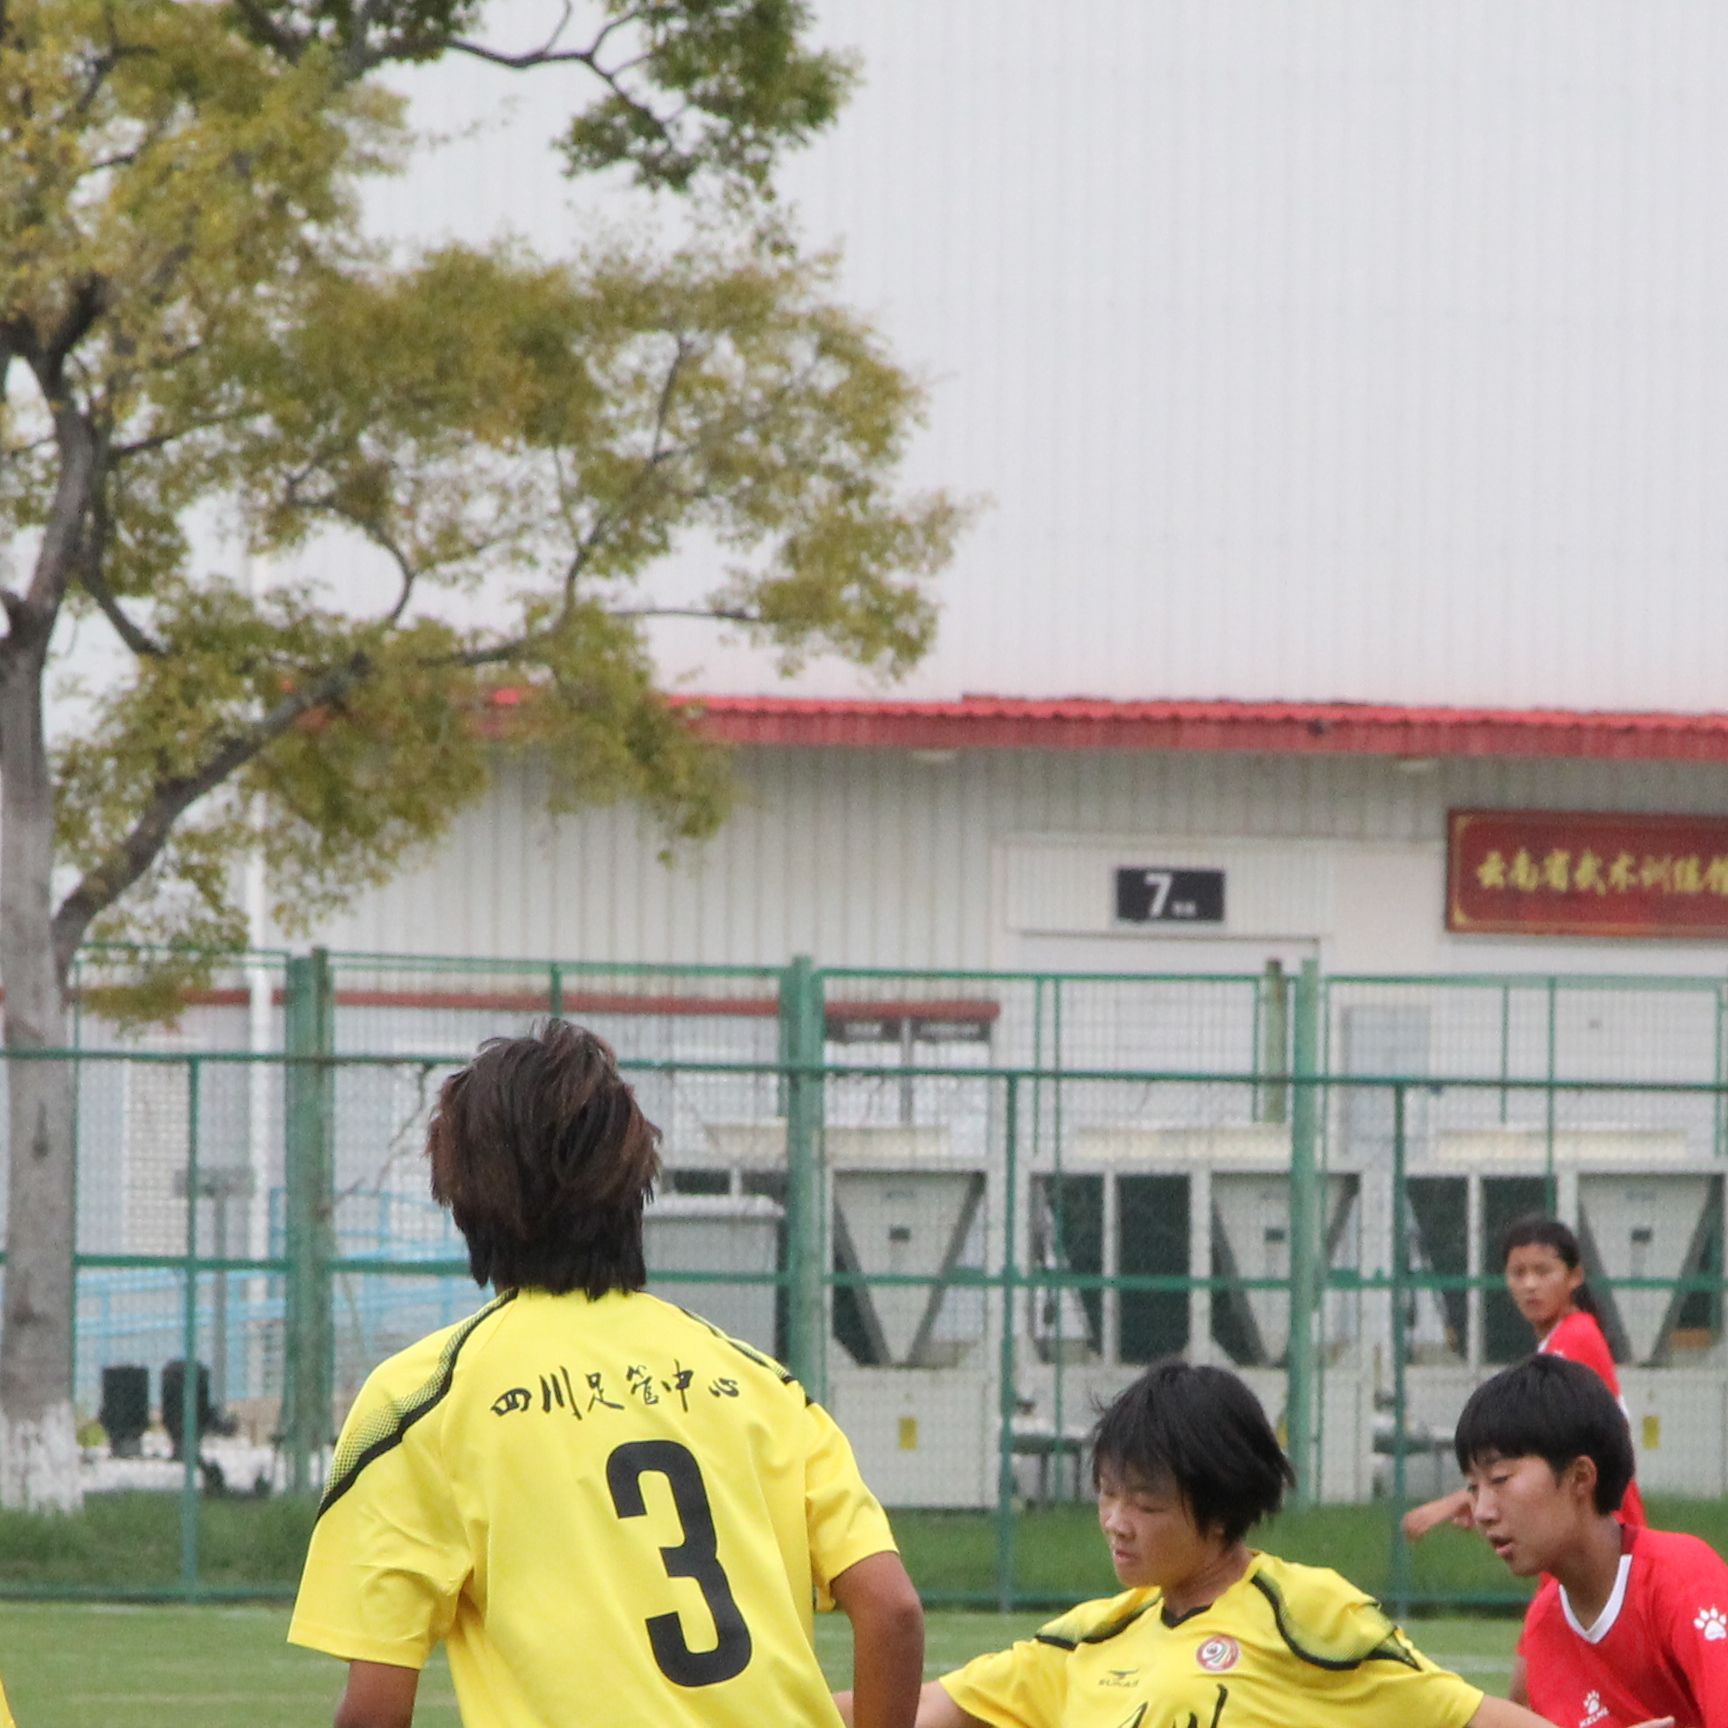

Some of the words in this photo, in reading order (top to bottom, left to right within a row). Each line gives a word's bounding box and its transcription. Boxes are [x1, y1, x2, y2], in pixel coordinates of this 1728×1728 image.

[1144, 872, 1172, 917] 7
[490, 1358, 739, 1421] 四川足管中心
[606, 1439, 752, 1688] 3
